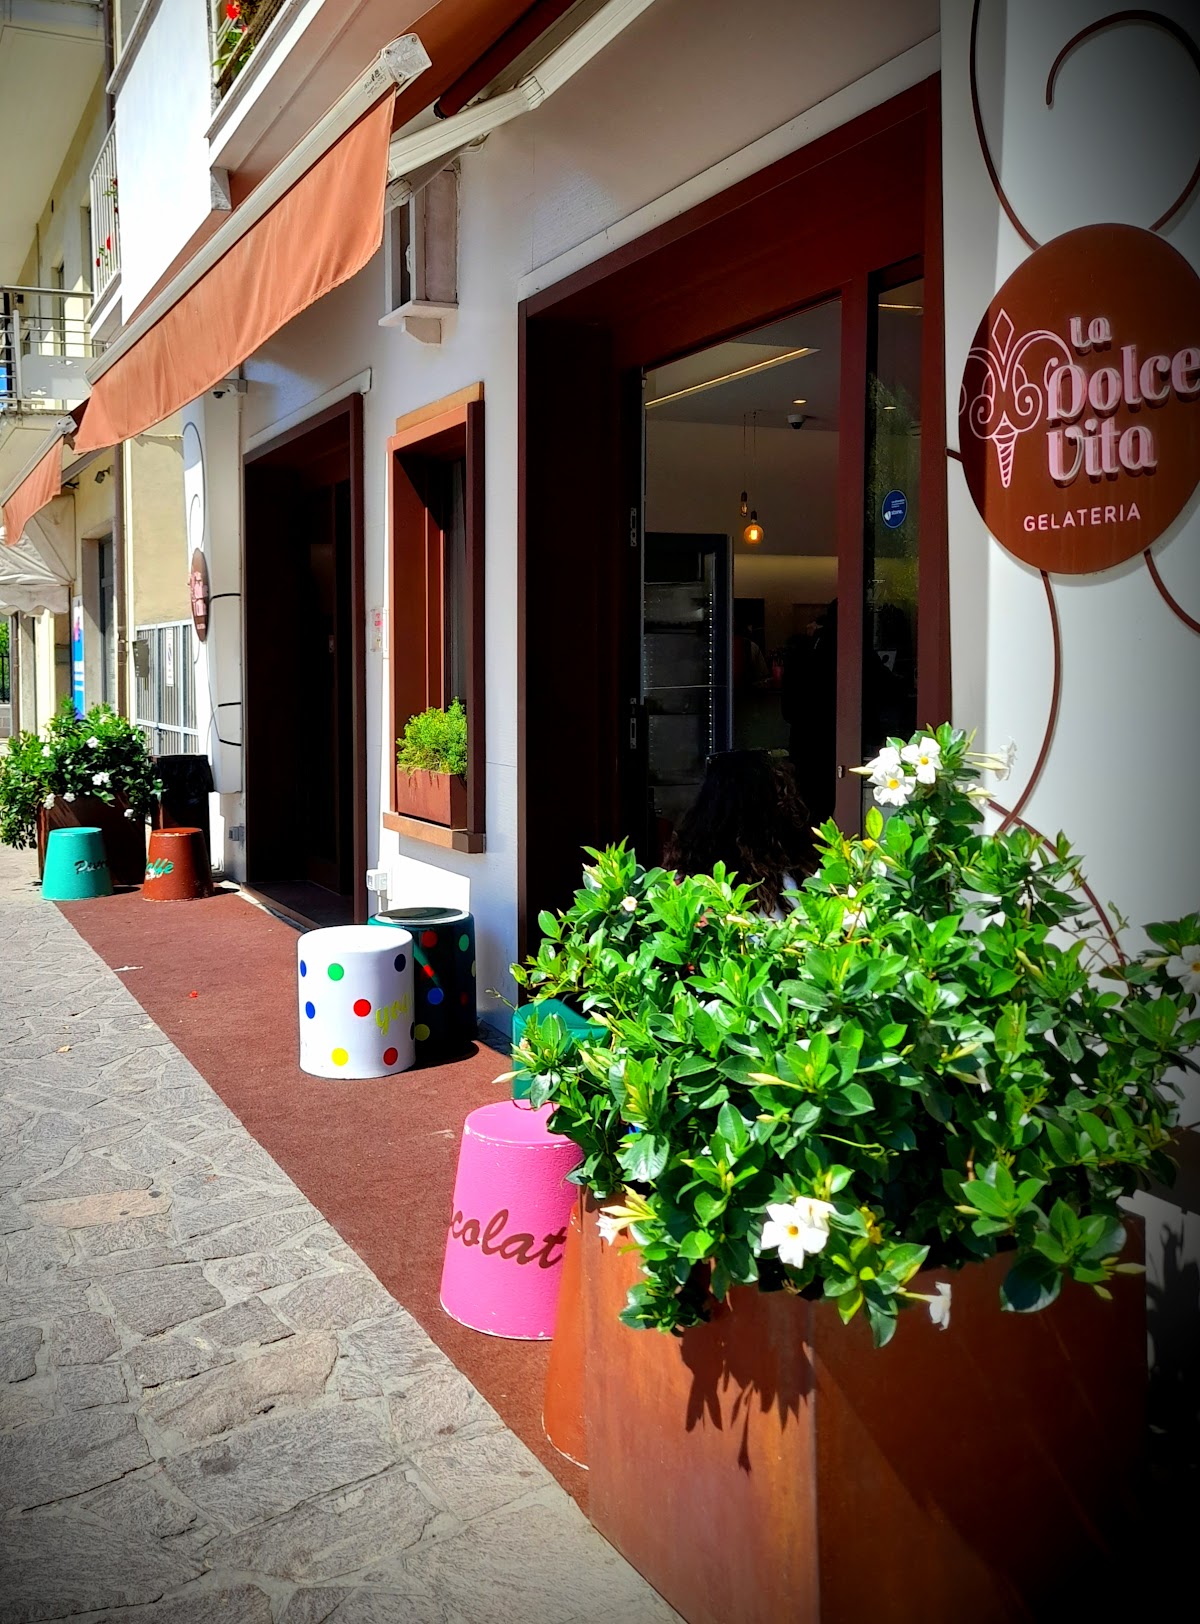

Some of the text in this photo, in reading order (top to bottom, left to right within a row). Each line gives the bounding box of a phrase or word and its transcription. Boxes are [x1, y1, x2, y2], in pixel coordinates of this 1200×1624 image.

[1070, 316, 1112, 349] La
[1044, 344, 1200, 421] Dolce
[1046, 417, 1158, 482] Vita
[1022, 502, 1141, 532] GELATERIA
